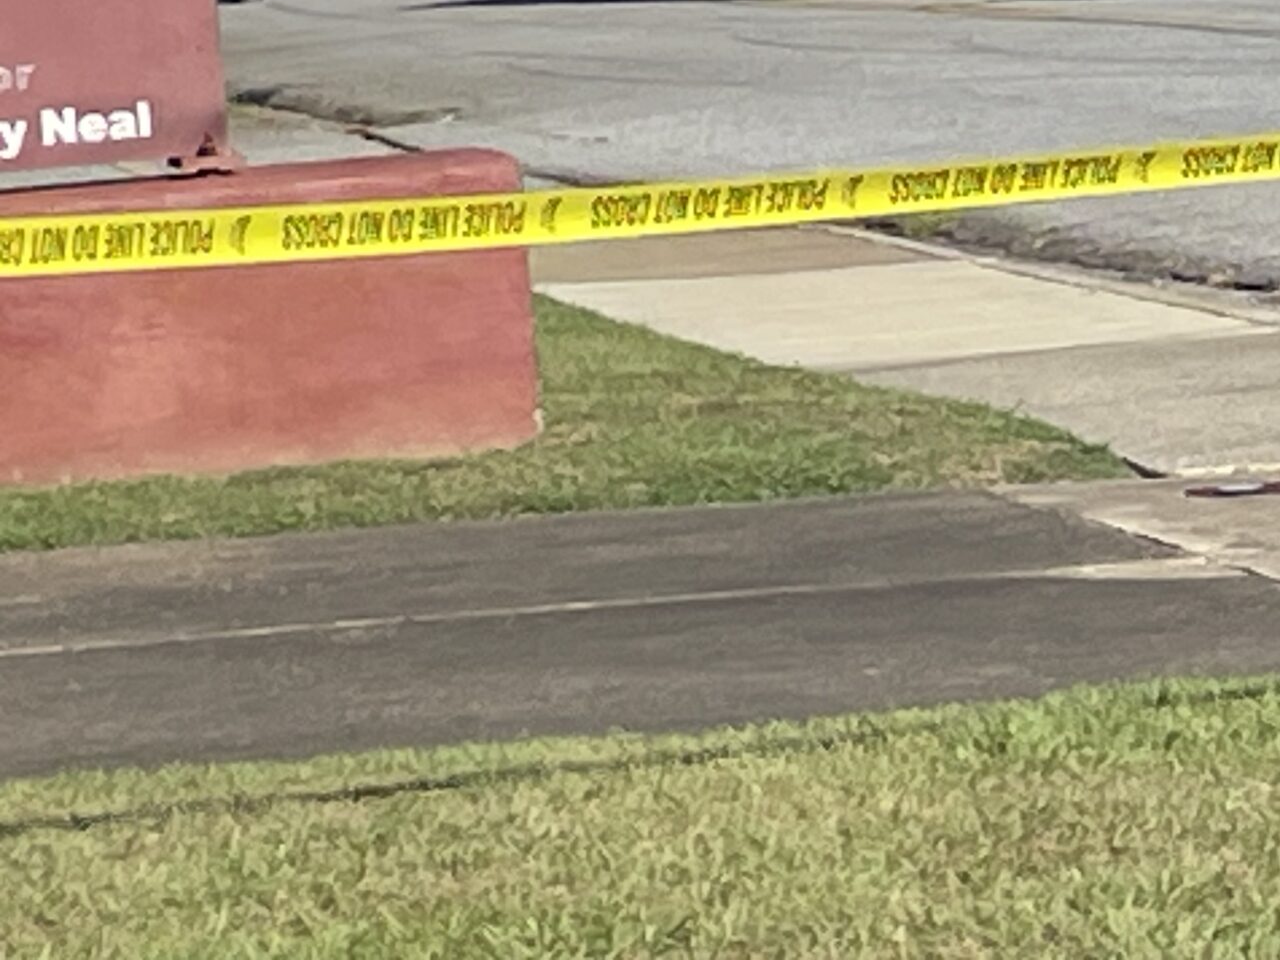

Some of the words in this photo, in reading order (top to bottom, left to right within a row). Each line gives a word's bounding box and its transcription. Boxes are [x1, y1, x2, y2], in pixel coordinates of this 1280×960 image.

[39, 100, 152, 146] Neal
[1060, 154, 1121, 188] POLICE
[1240, 140, 1277, 172] NOT
[951, 165, 987, 197] NOT
[989, 163, 1016, 194] DO
[1019, 159, 1058, 192] LINE
[654, 188, 690, 222] NOT
[693, 186, 720, 219] DO
[723, 183, 763, 217] LINE
[765, 178, 830, 214] POLICE
[347, 209, 384, 245] NOT
[388, 208, 414, 242] DO
[419, 205, 459, 240] LINE
[462, 200, 526, 237] POLICE
[29, 226, 67, 262] NOT
[72, 224, 99, 260] DO
[103, 222, 146, 259] LINE
[149, 219, 214, 257] POLICE
